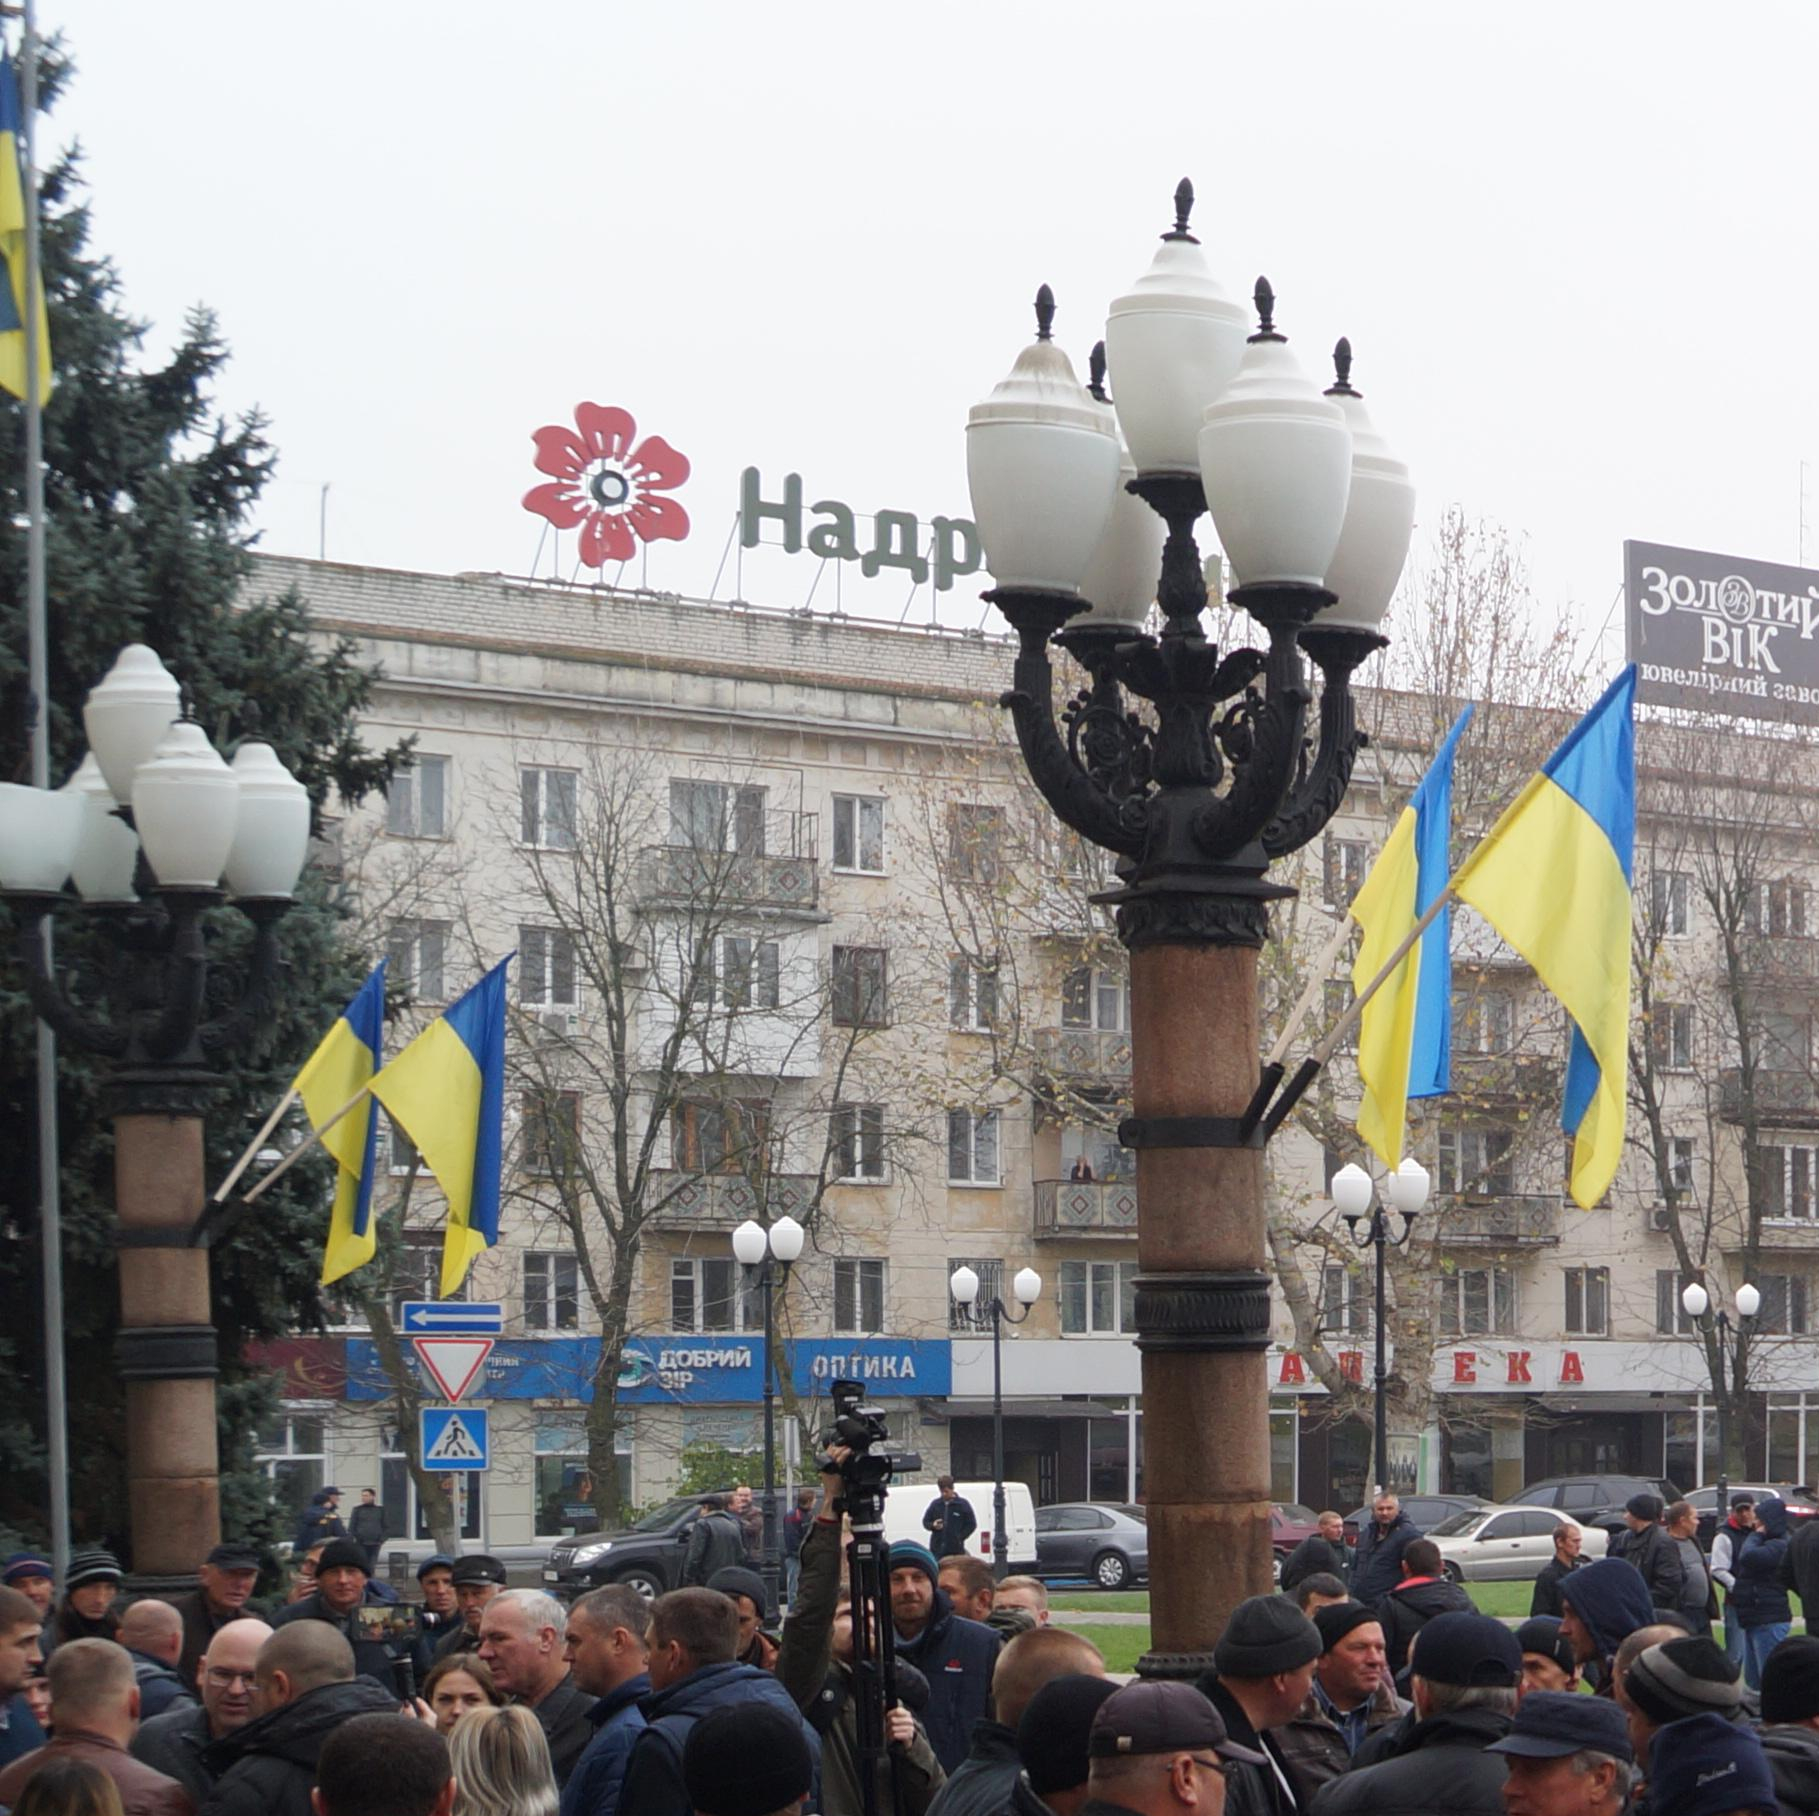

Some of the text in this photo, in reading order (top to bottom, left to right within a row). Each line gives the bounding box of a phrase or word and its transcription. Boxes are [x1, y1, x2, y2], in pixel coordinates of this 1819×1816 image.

[740, 466, 984, 591] Надр
[658, 1345, 752, 1368] ДОБРИЙ
[813, 1355, 916, 1379] ОПТИКА
[1279, 1351, 1585, 1384] АПЕКА
[659, 1371, 693, 1389] ЗІР
